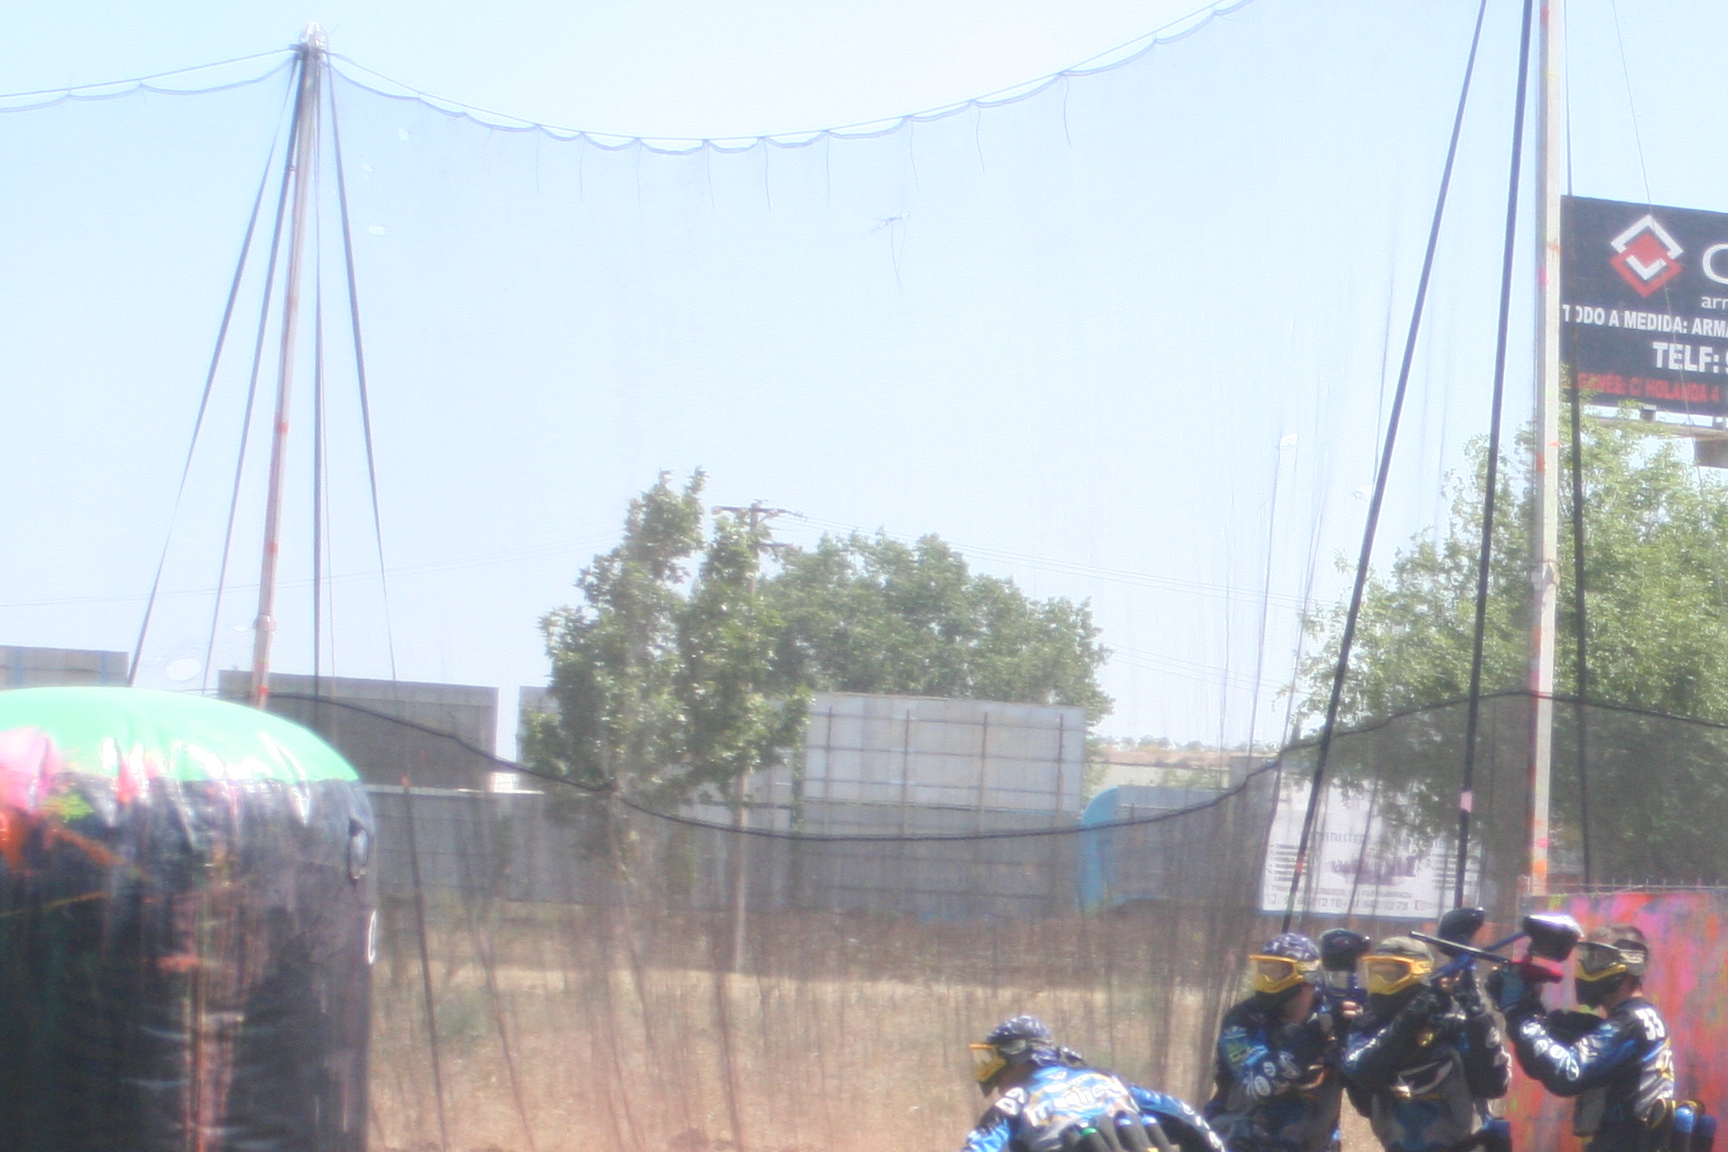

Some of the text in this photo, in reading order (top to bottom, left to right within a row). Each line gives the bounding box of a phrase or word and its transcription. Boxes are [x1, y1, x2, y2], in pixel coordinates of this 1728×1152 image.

[1609, 309, 1619, 328] A
[1623, 310, 1688, 334] MEDIDA:
[1652, 341, 1719, 374] TELF:
